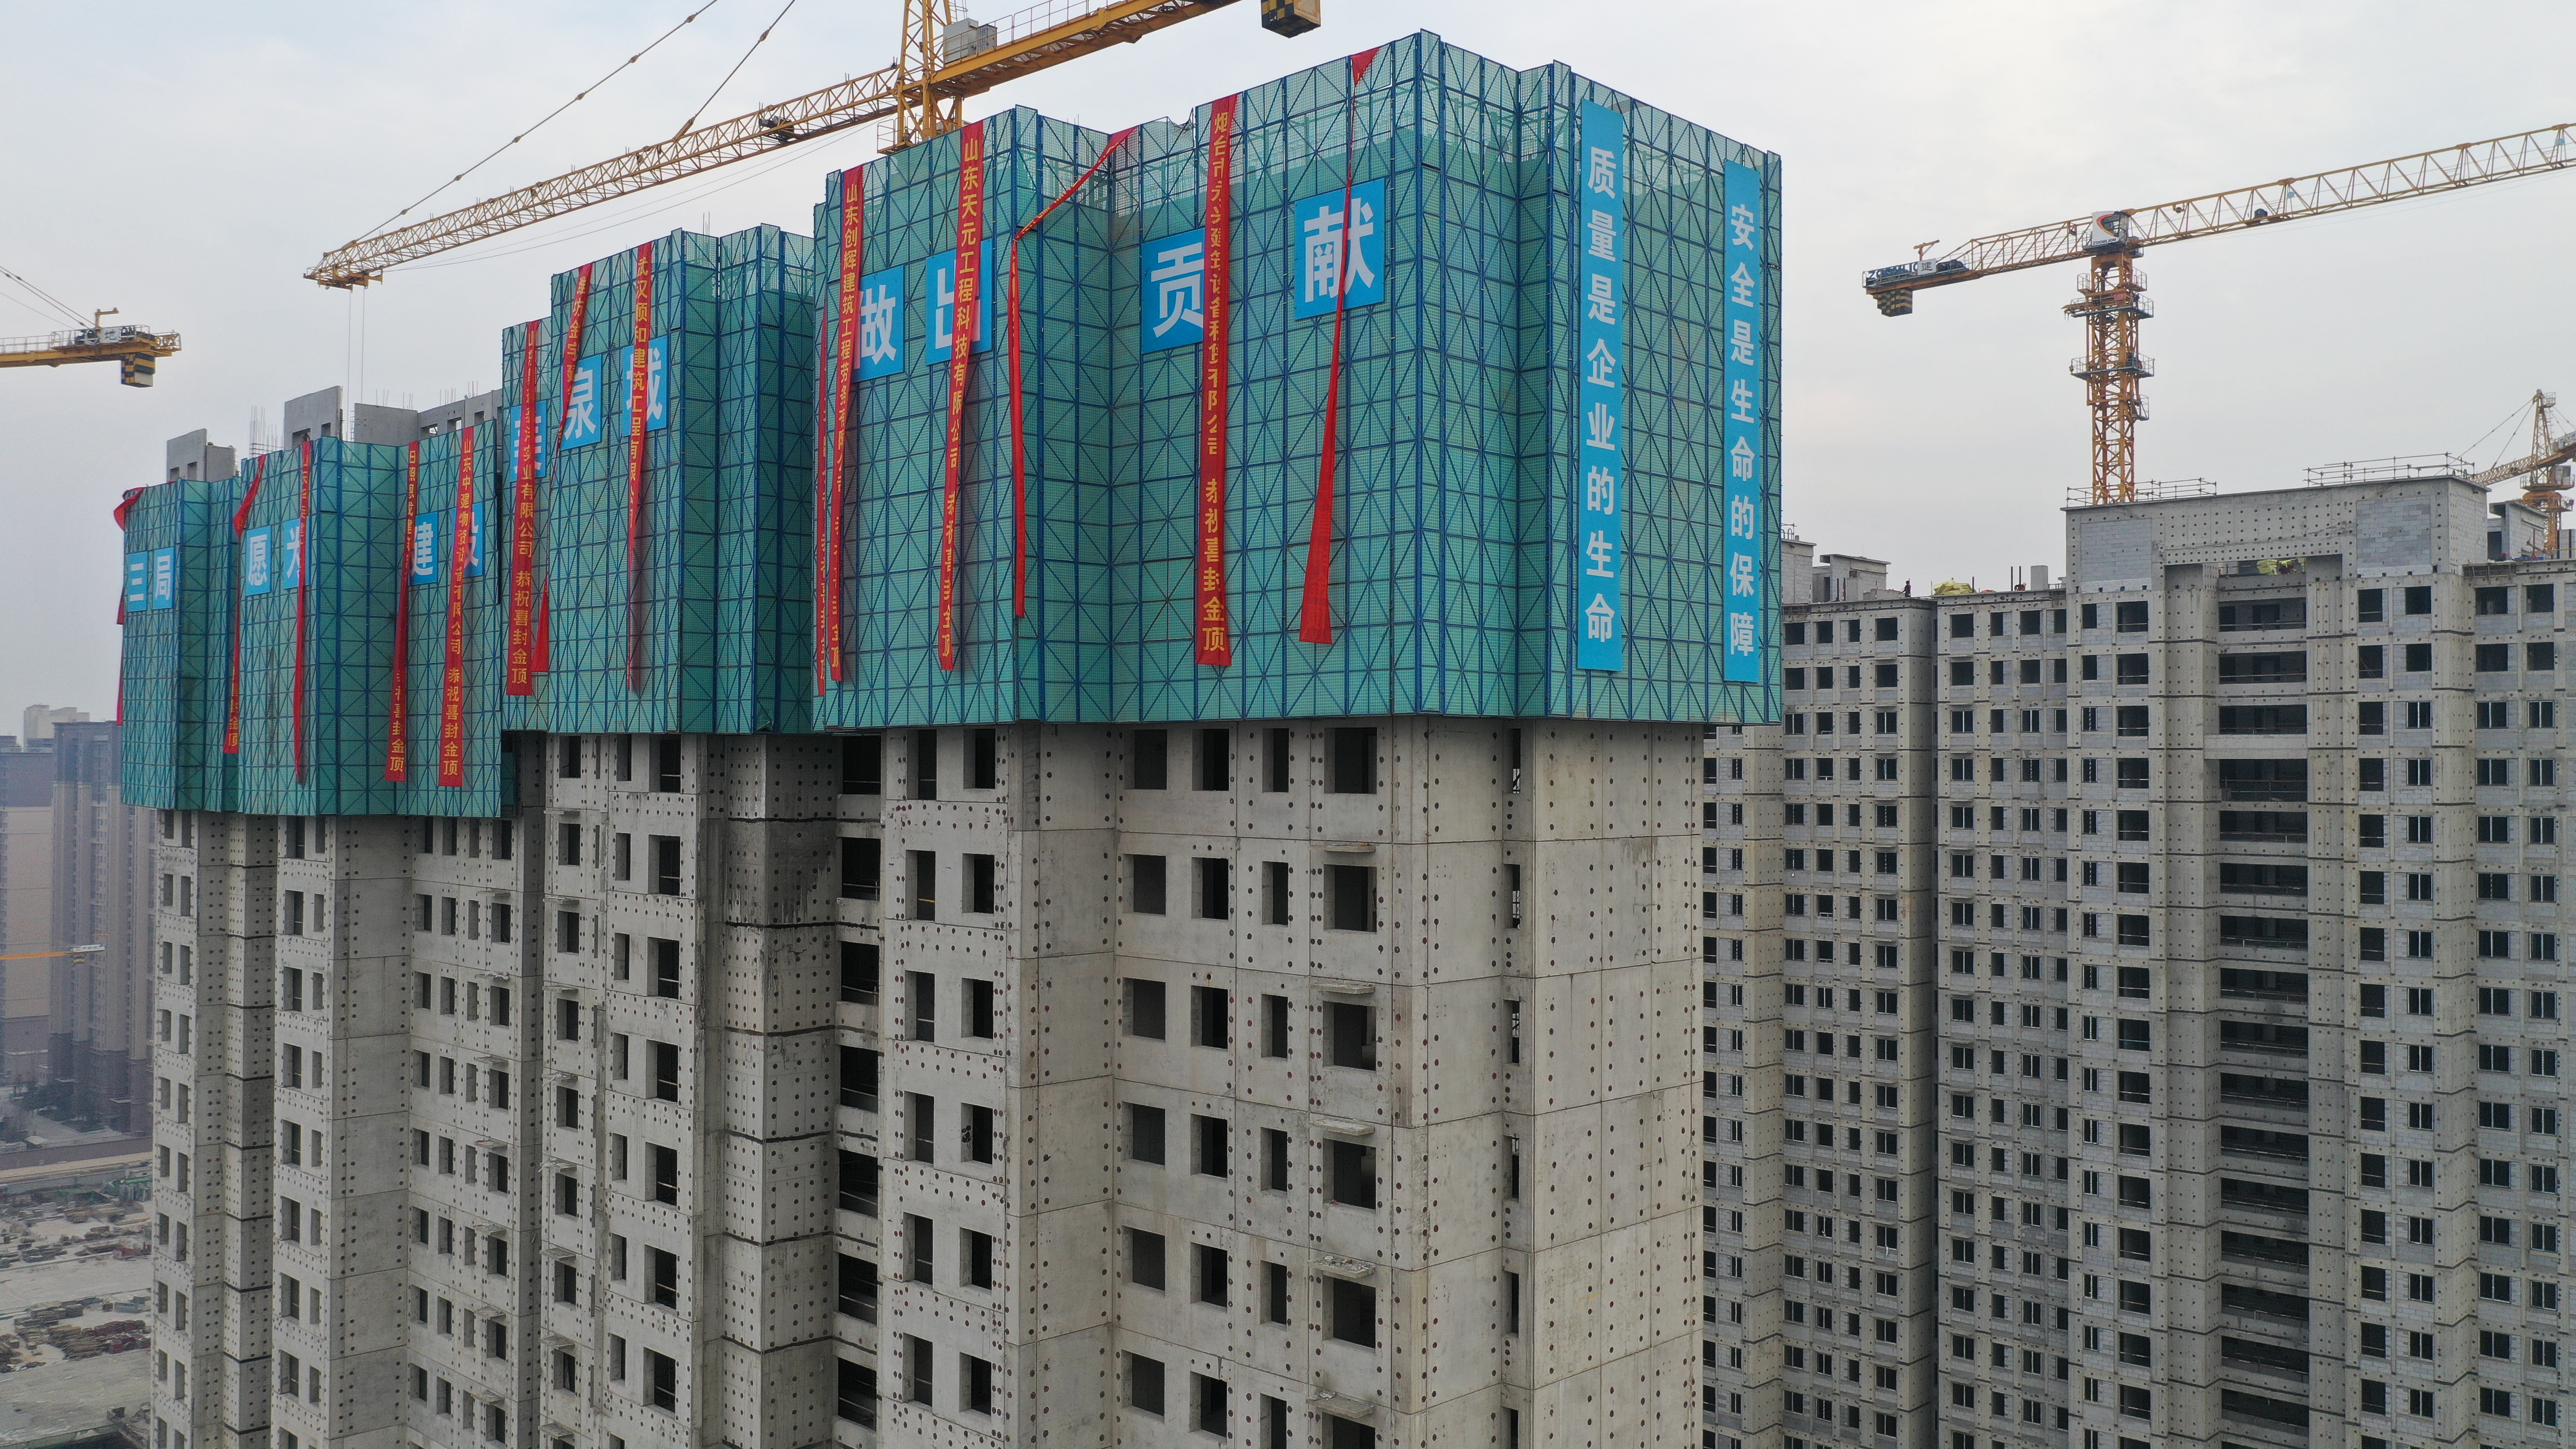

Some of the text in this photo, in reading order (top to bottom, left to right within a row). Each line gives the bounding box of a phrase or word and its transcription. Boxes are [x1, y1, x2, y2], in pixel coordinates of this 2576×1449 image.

[950, 138, 978, 469] 山东天元工程科技有限公司
[1151, 198, 1375, 338] 贡献
[1585, 146, 1617, 643] 质量是企业的生命
[1730, 204, 1755, 656] 安全是生命的保障
[129, 555, 171, 602] 三局
[512, 571, 530, 684] 恭祝喜封金顶
